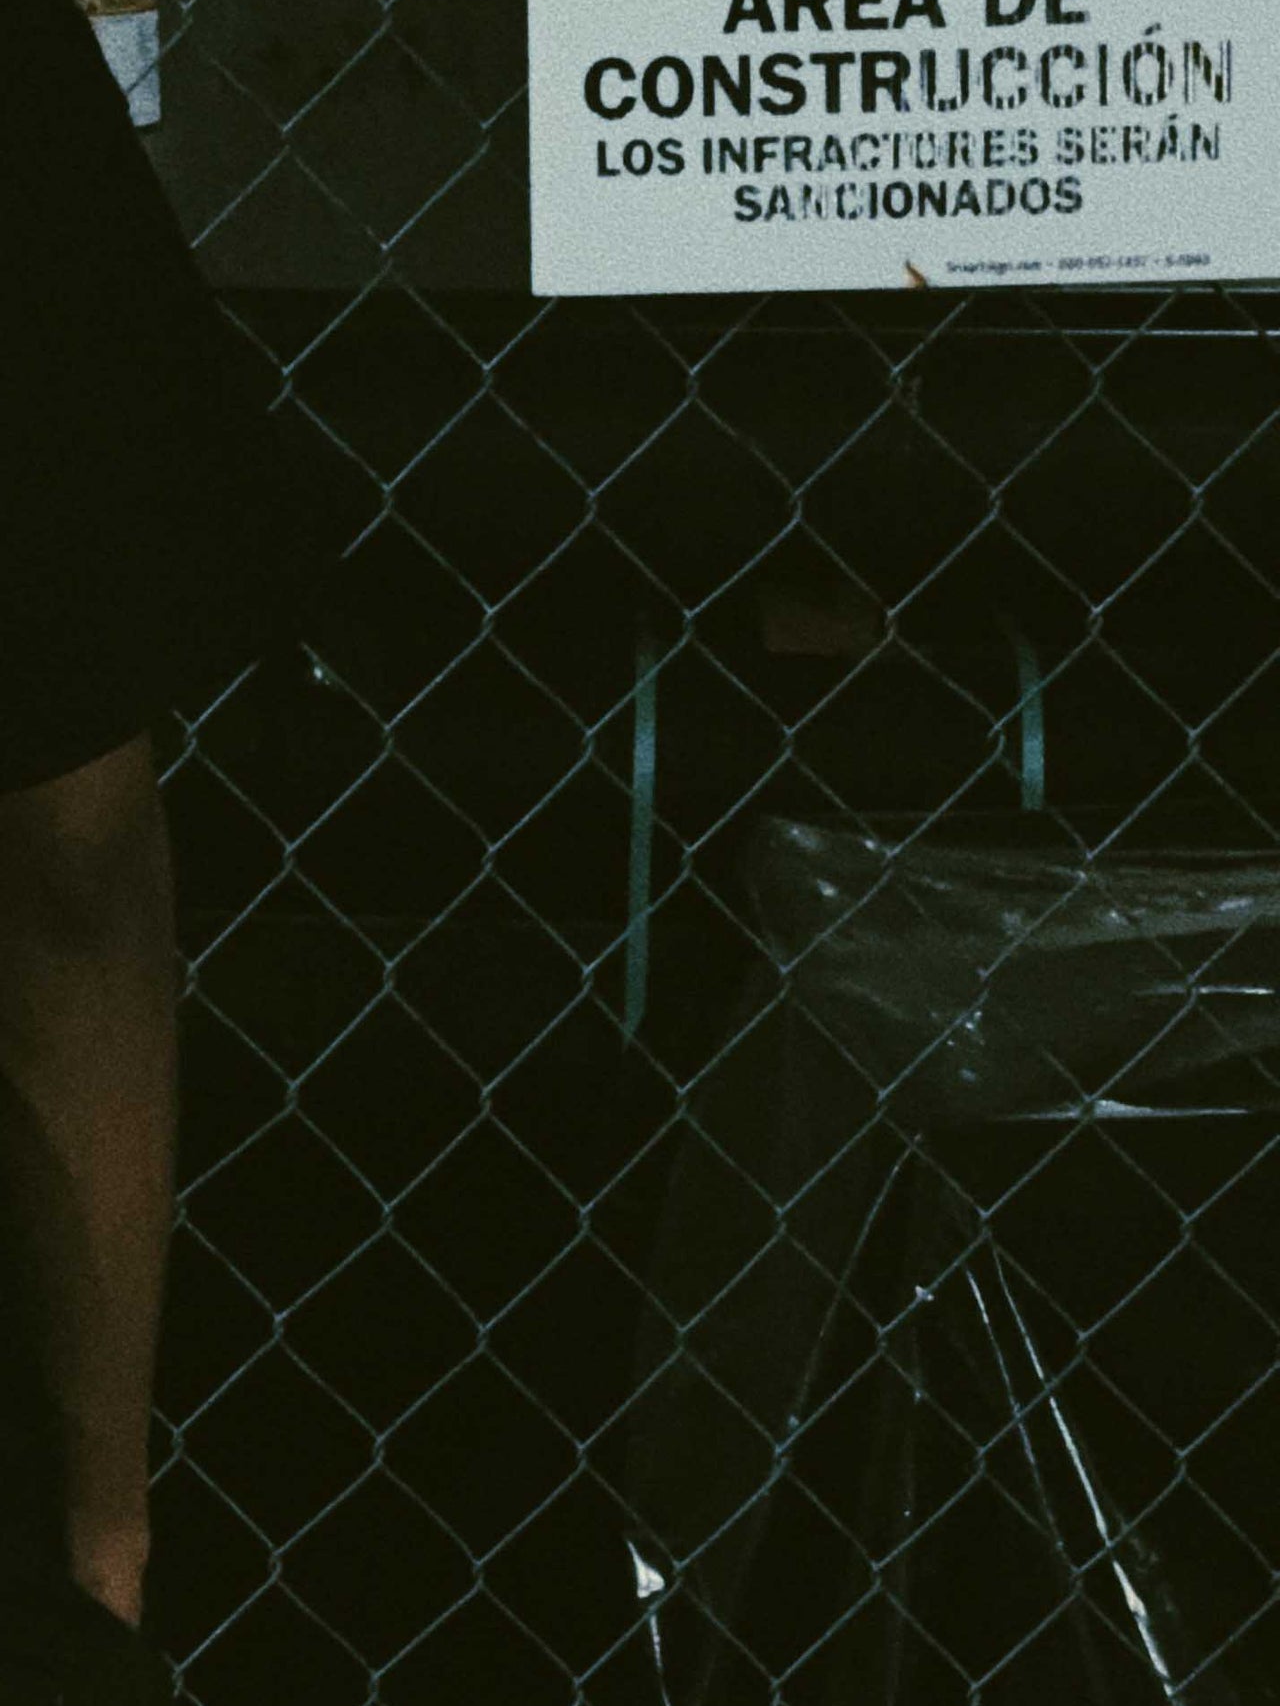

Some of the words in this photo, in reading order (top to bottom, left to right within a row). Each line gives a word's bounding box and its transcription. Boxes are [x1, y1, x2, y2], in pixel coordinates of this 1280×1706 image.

[583, 24, 1233, 121] CONSTRUCCIÓN
[596, 137, 686, 178] LOS
[702, 128, 1040, 175] INFRACTORES
[1054, 115, 1222, 165] SERÁN
[733, 176, 1084, 223] SANCIONADOS
